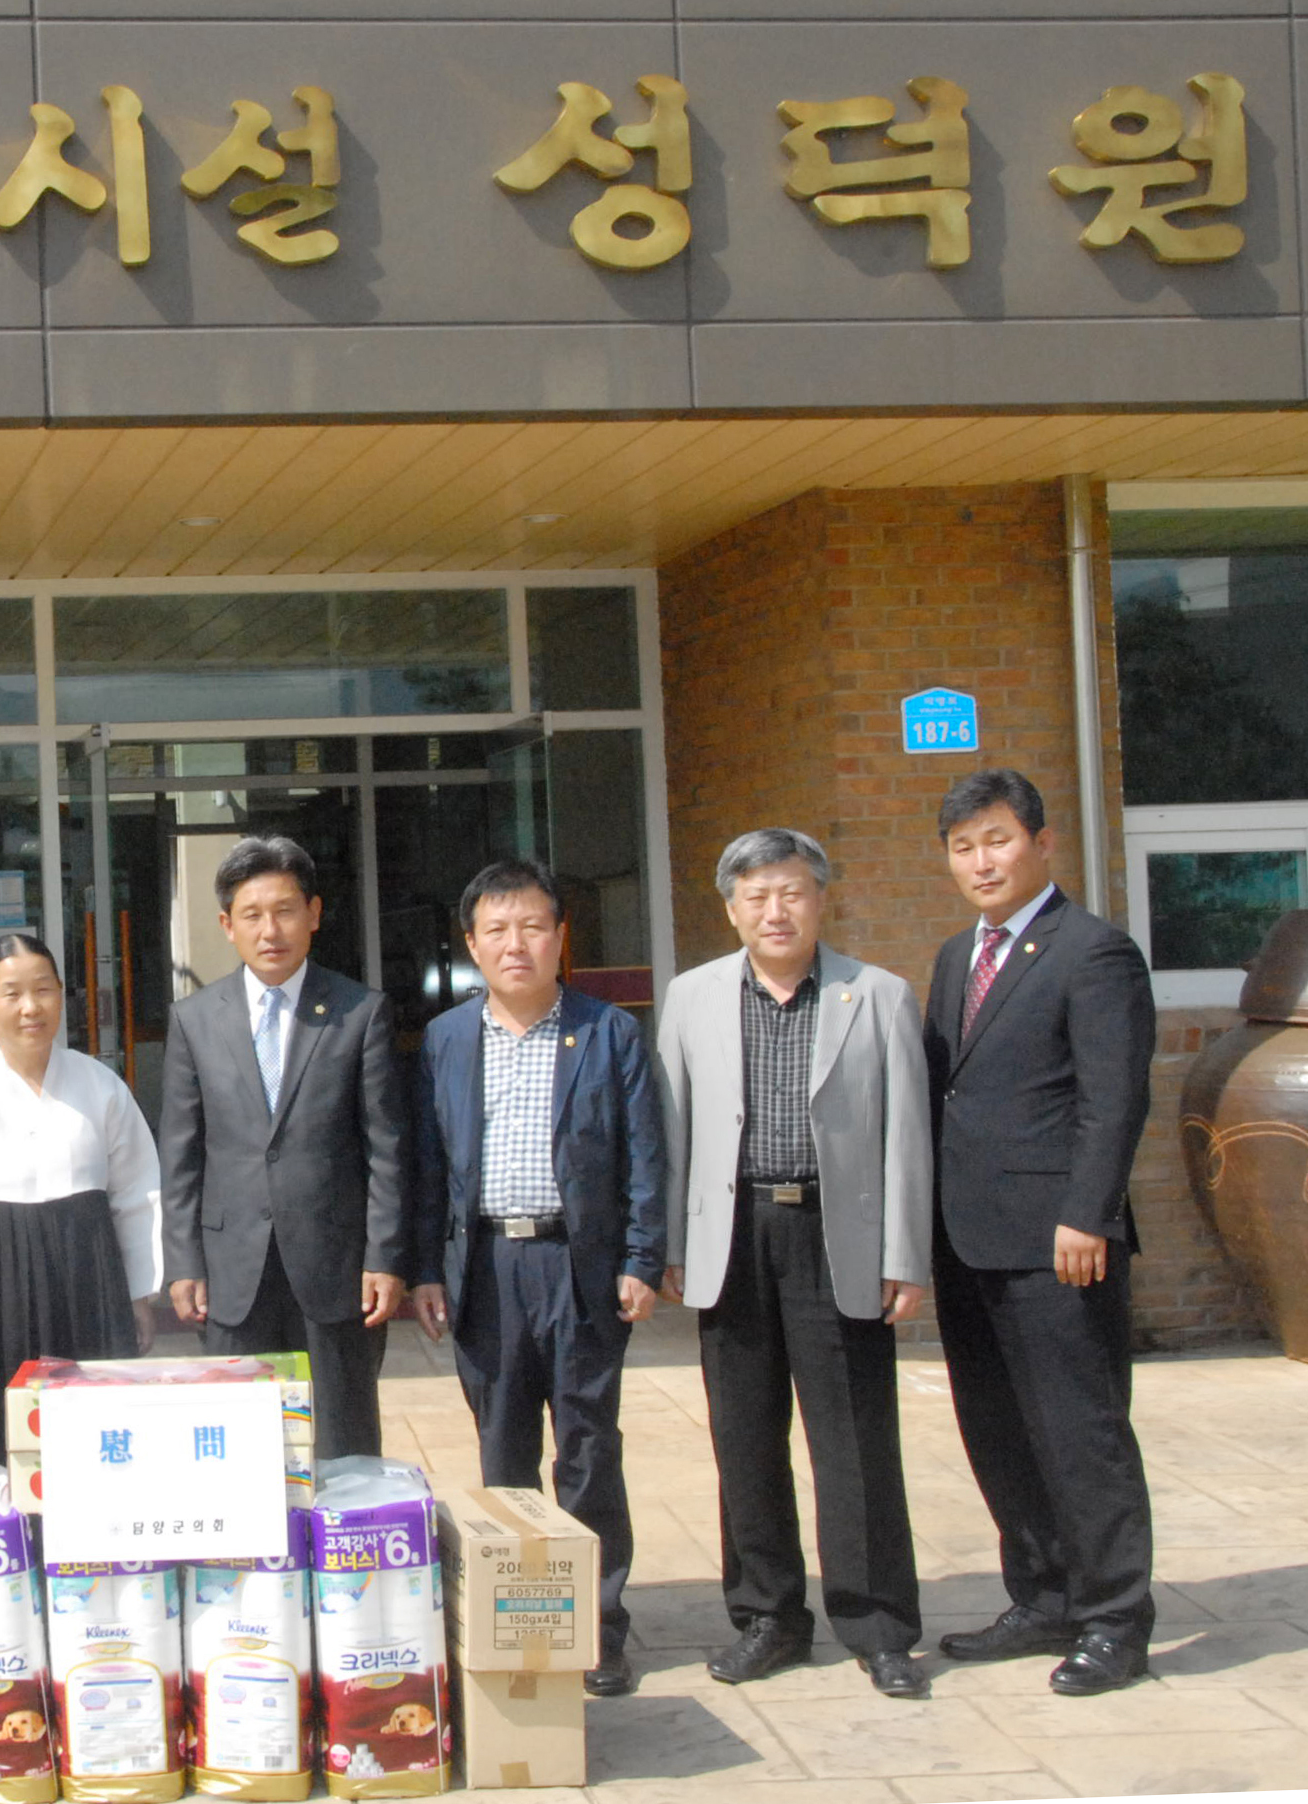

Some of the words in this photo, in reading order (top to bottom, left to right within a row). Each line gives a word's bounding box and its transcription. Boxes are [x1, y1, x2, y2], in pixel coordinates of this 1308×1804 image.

[493, 72, 1249, 271] 성덕원
[913, 720, 971, 743] 187-6
[132, 1518, 224, 1536] 담양군의회
[323, 1549, 380, 1571] 보너스!
[507, 1587, 562, 1598] 6057769
[85, 1626, 131, 1639] Kleenex
[227, 1619, 270, 1636] Kleenex
[339, 1648, 420, 1671] 크리넥스
